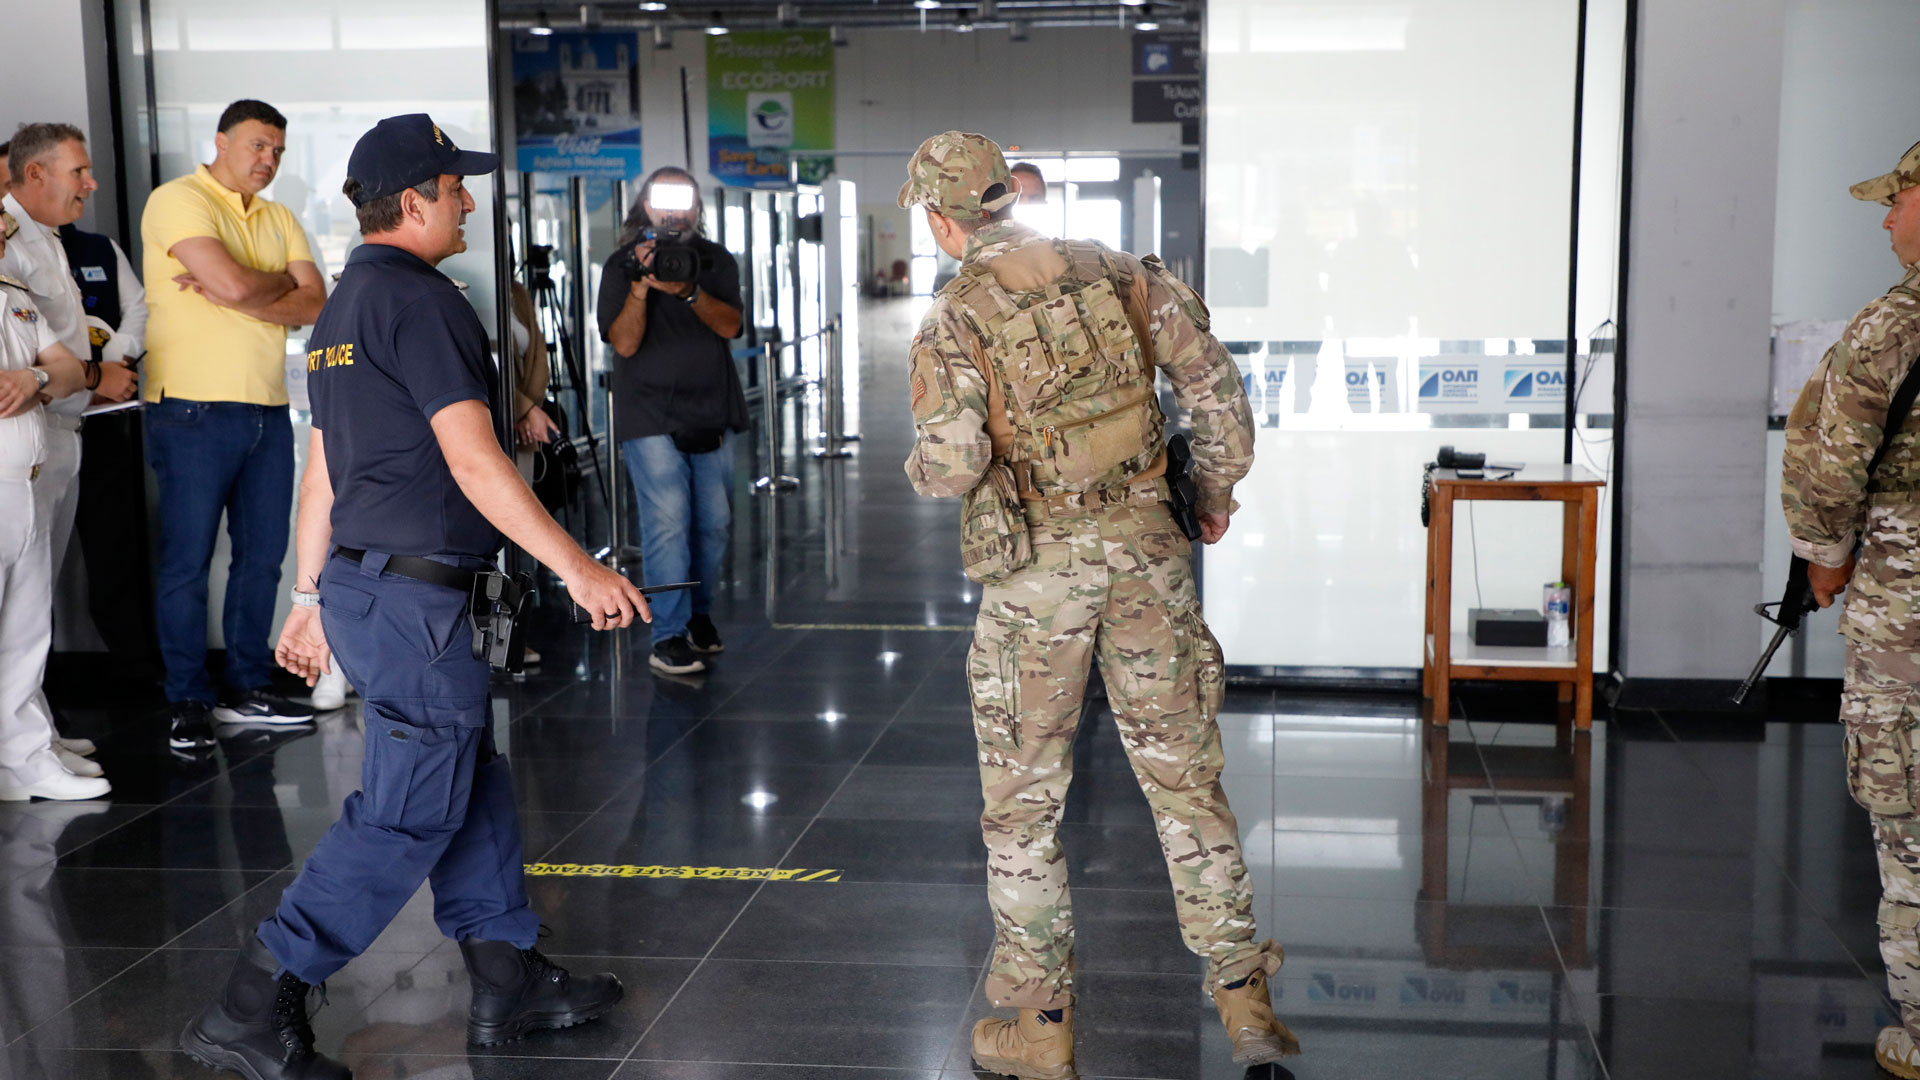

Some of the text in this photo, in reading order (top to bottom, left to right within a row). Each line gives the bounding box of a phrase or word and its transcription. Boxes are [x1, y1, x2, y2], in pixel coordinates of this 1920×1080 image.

[721, 71, 832, 90] ECOPORT
[553, 132, 602, 156] Visit
[718, 149, 756, 163] Save
[323, 343, 354, 370] POLICE
[1535, 370, 1566, 385] ΟΛ
[628, 866, 688, 876] SAFE
[711, 869, 769, 877] KEEP
